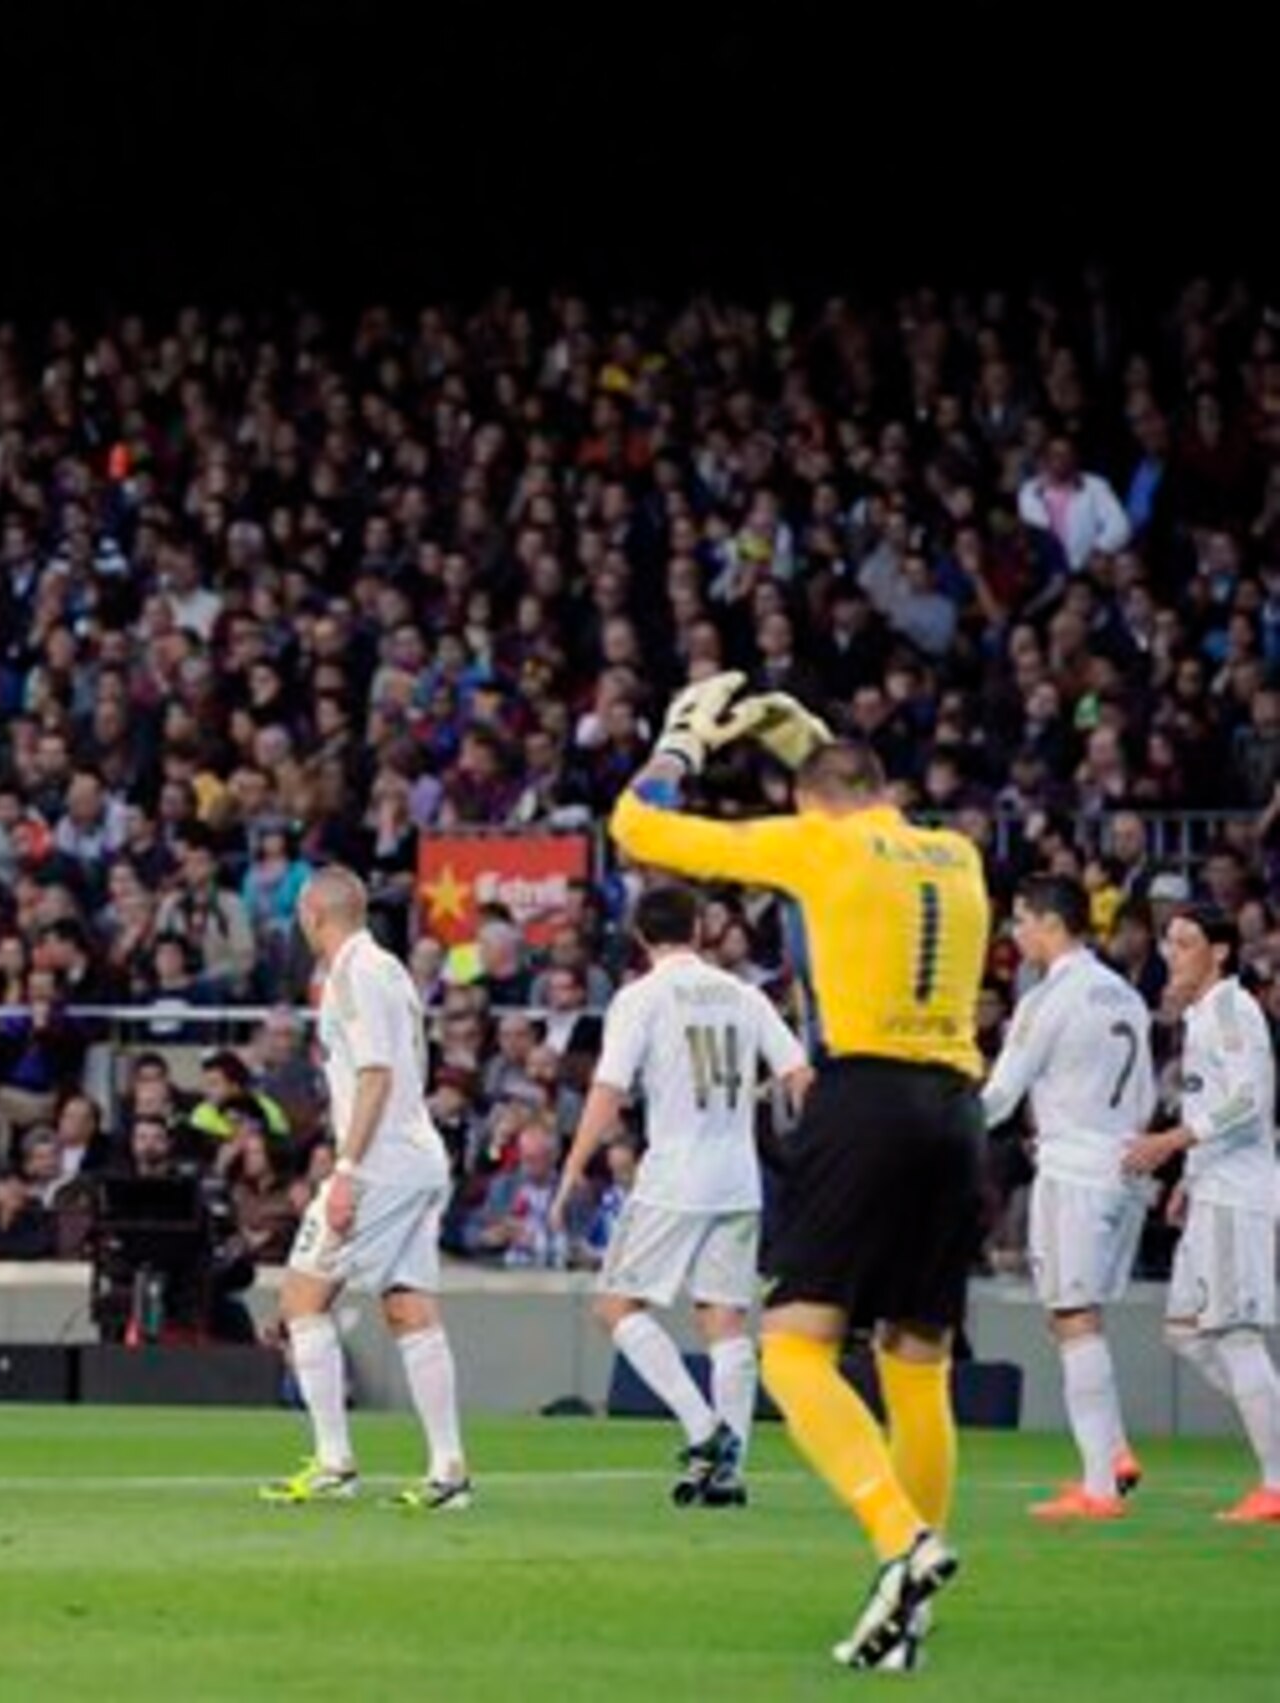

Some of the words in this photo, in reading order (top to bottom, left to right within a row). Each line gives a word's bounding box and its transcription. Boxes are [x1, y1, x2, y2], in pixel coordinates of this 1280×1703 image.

[916, 882, 938, 1004] 1
[684, 1023, 742, 1112] 14
[1109, 1020, 1138, 1109] 7
